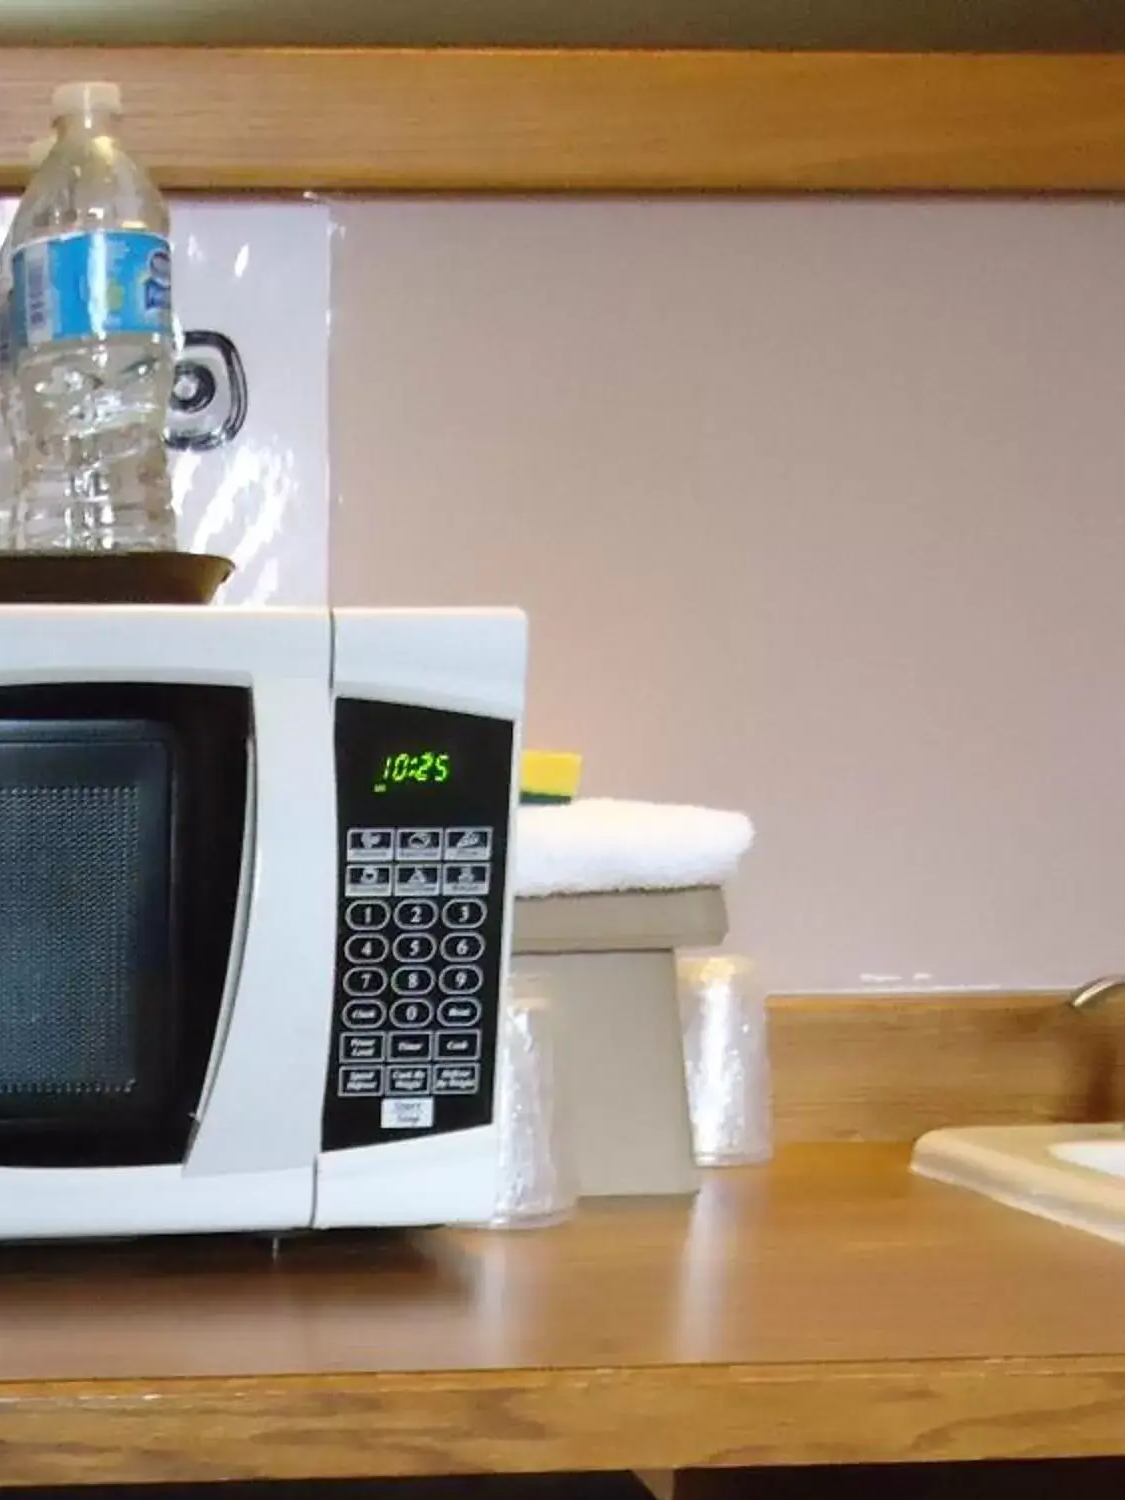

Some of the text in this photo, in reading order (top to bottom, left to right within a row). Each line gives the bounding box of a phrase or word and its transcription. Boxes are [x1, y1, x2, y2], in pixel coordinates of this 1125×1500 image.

[382, 751, 450, 782] 10:25
[363, 906, 372, 924] 1
[410, 906, 422, 923] 2
[459, 905, 471, 922] 3
[361, 941, 373, 956] 4
[409, 939, 420, 956] 5
[456, 938, 468, 955] 6
[360, 973, 373, 989] 7
[408, 972, 419, 989] 8
[455, 972, 467, 988] 9
[406, 1005, 417, 1021] 0
